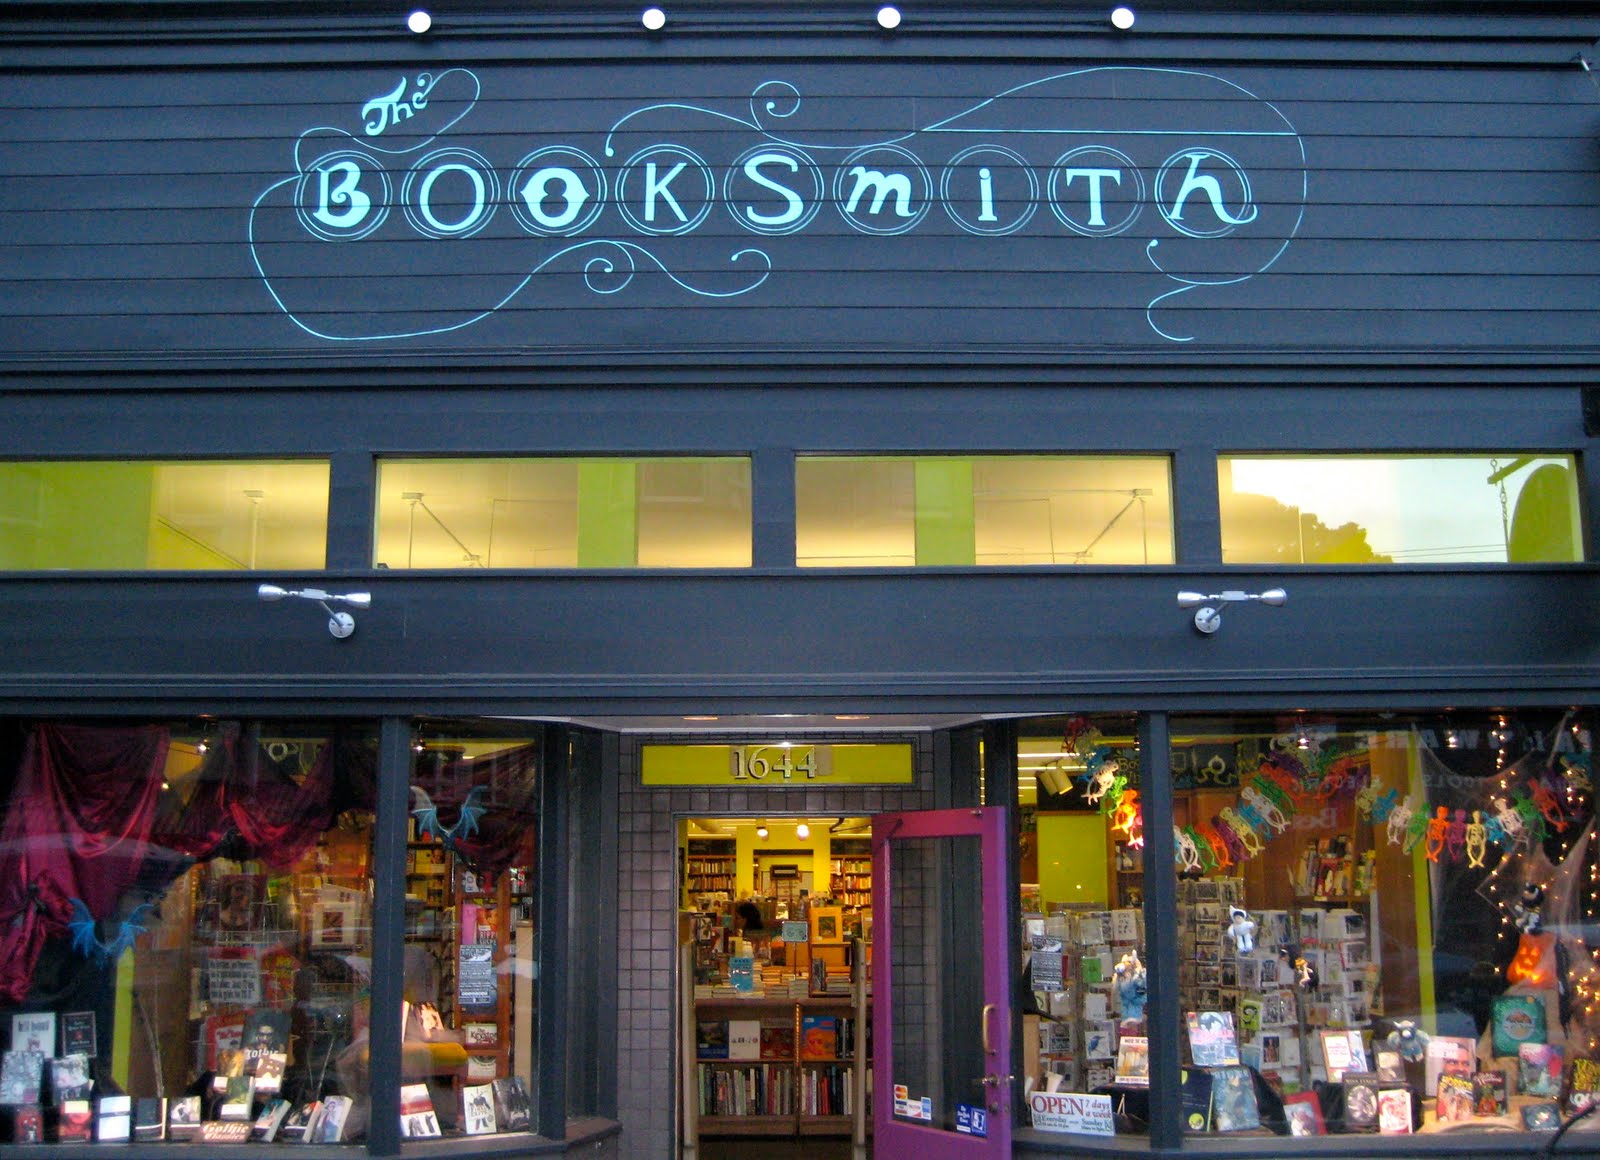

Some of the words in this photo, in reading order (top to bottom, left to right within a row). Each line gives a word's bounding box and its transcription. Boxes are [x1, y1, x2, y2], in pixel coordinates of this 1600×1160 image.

[361, 72, 432, 136] The
[732, 746, 818, 780] 1644
[1031, 1095, 1085, 1116] OPEN
[1085, 1099, 1090, 1108] 7
[1091, 1100, 1110, 1112] days
[1091, 1111, 1112, 1119] week
[1081, 1117, 1103, 1126] Sunday
